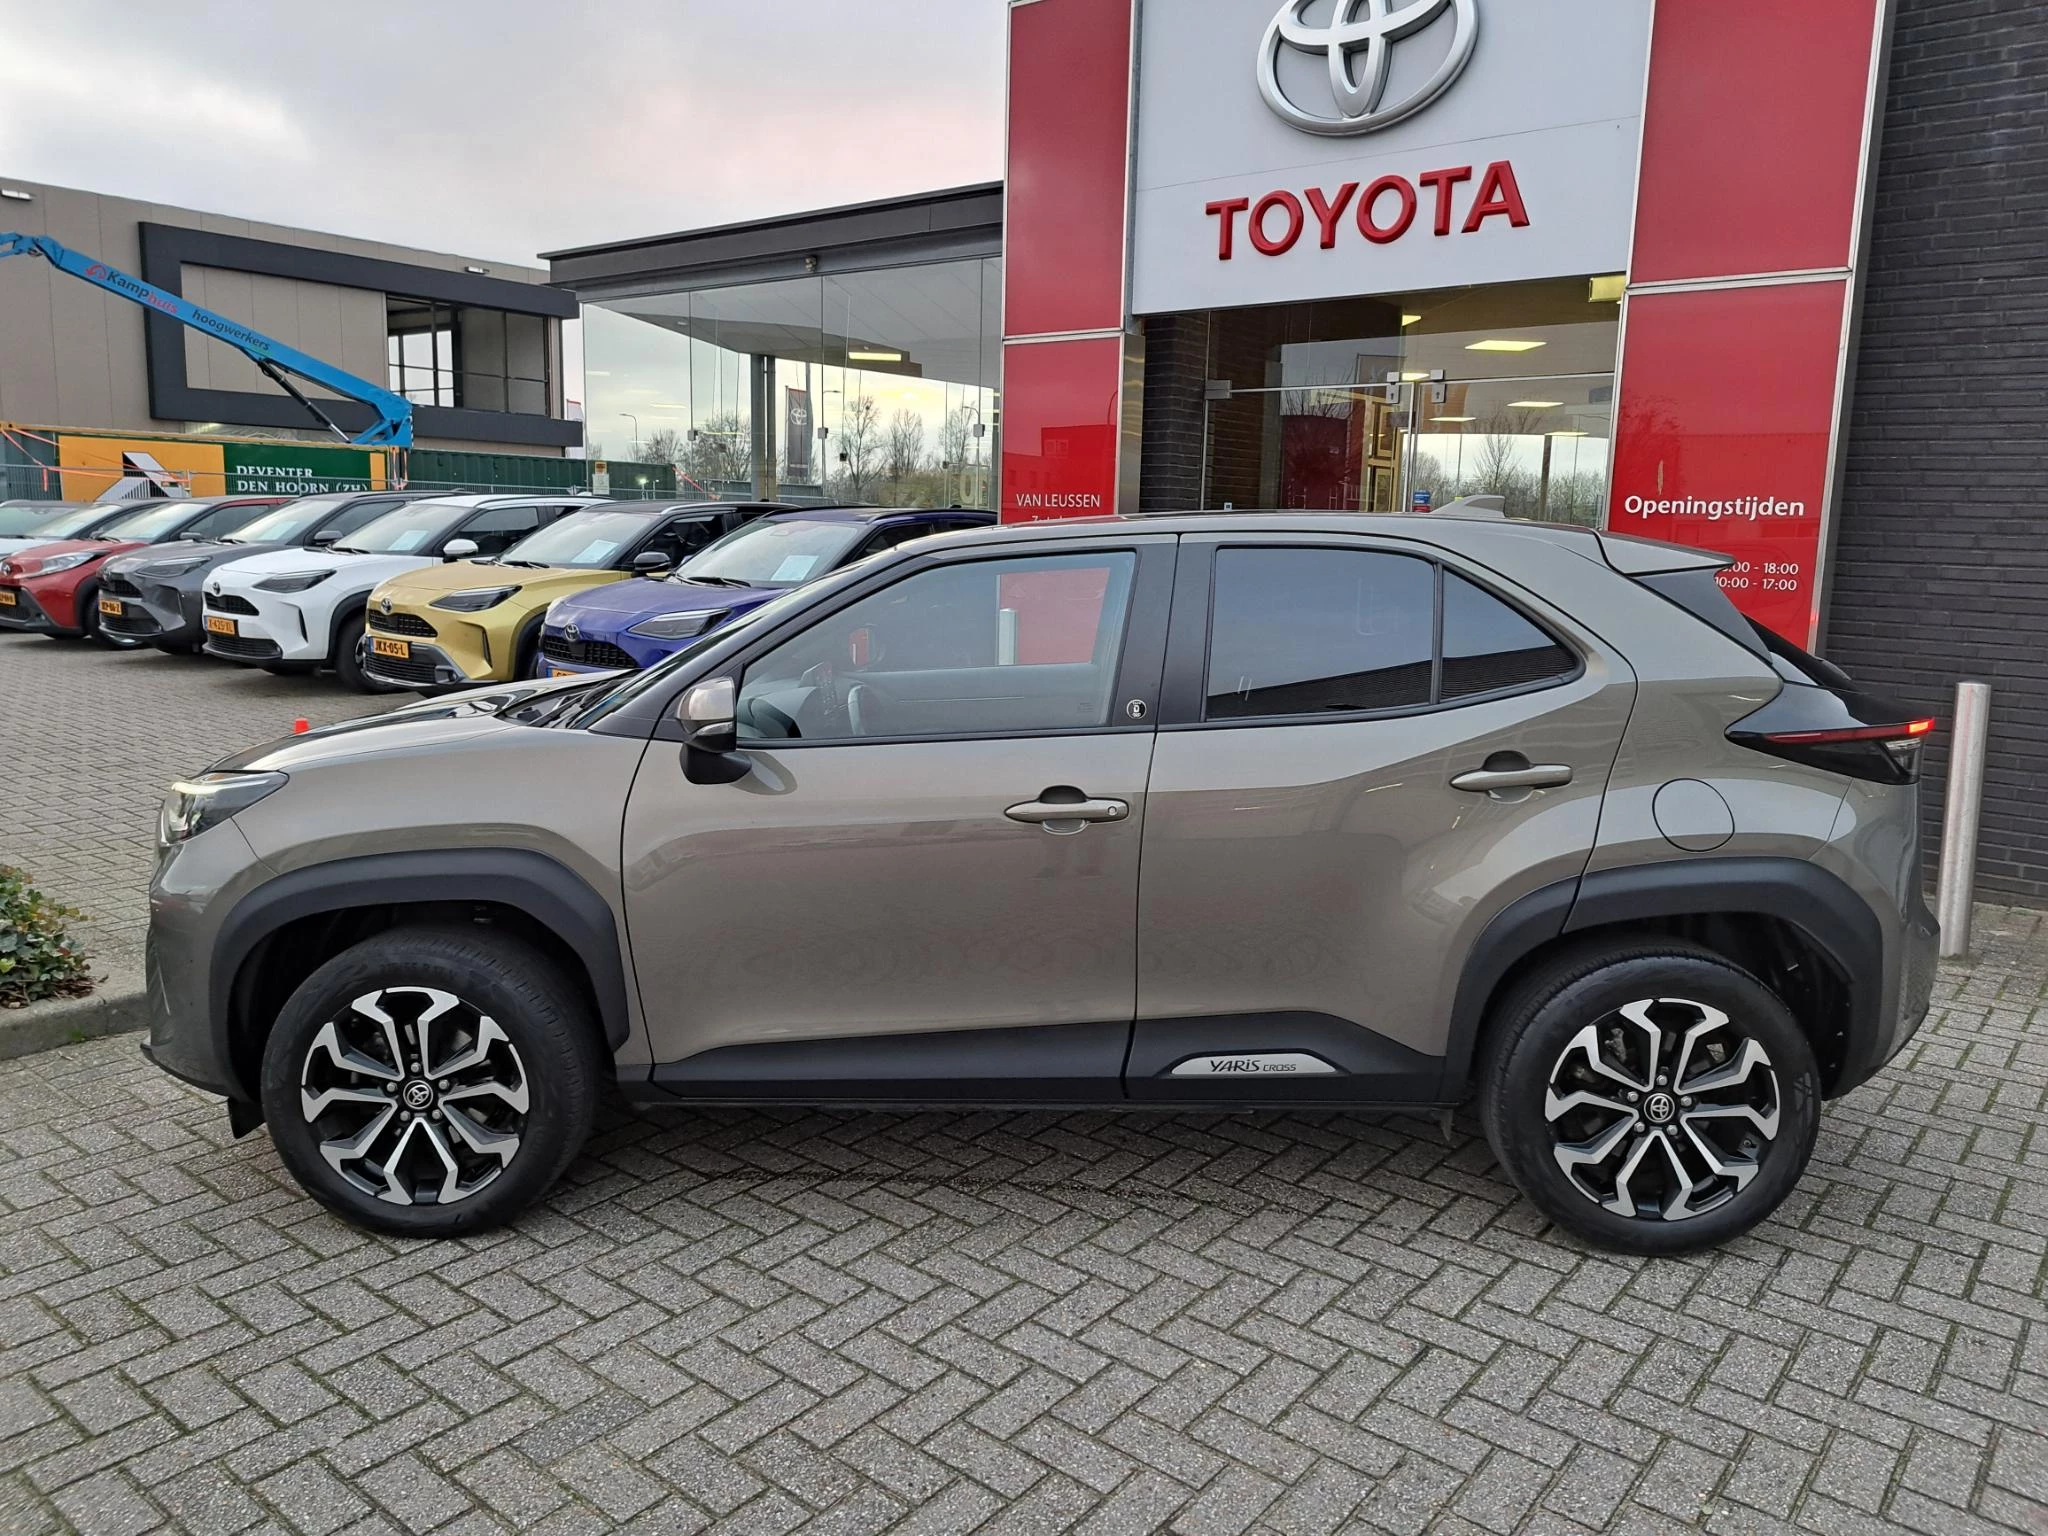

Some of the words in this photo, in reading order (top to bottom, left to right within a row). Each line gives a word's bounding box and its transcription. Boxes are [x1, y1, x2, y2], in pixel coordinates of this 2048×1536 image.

[1205, 160, 1530, 260] TOYOTA
[106, 270, 177, 314] Kamphuis
[191, 308, 271, 351] hoogwerkers
[236, 465, 313, 478] DEVENTER
[237, 480, 268, 492] DEN
[275, 481, 330, 493] HOORN
[1016, 493, 1041, 507] VAN
[1045, 493, 1100, 508] LEUSSEN
[1624, 495, 1805, 521] Openingstijden
[1763, 562, 1799, 575] 18:00
[1715, 576, 1749, 588] 10:00
[1762, 578, 1797, 591] 17:00
[1263, 1063, 1297, 1072] CROSS
